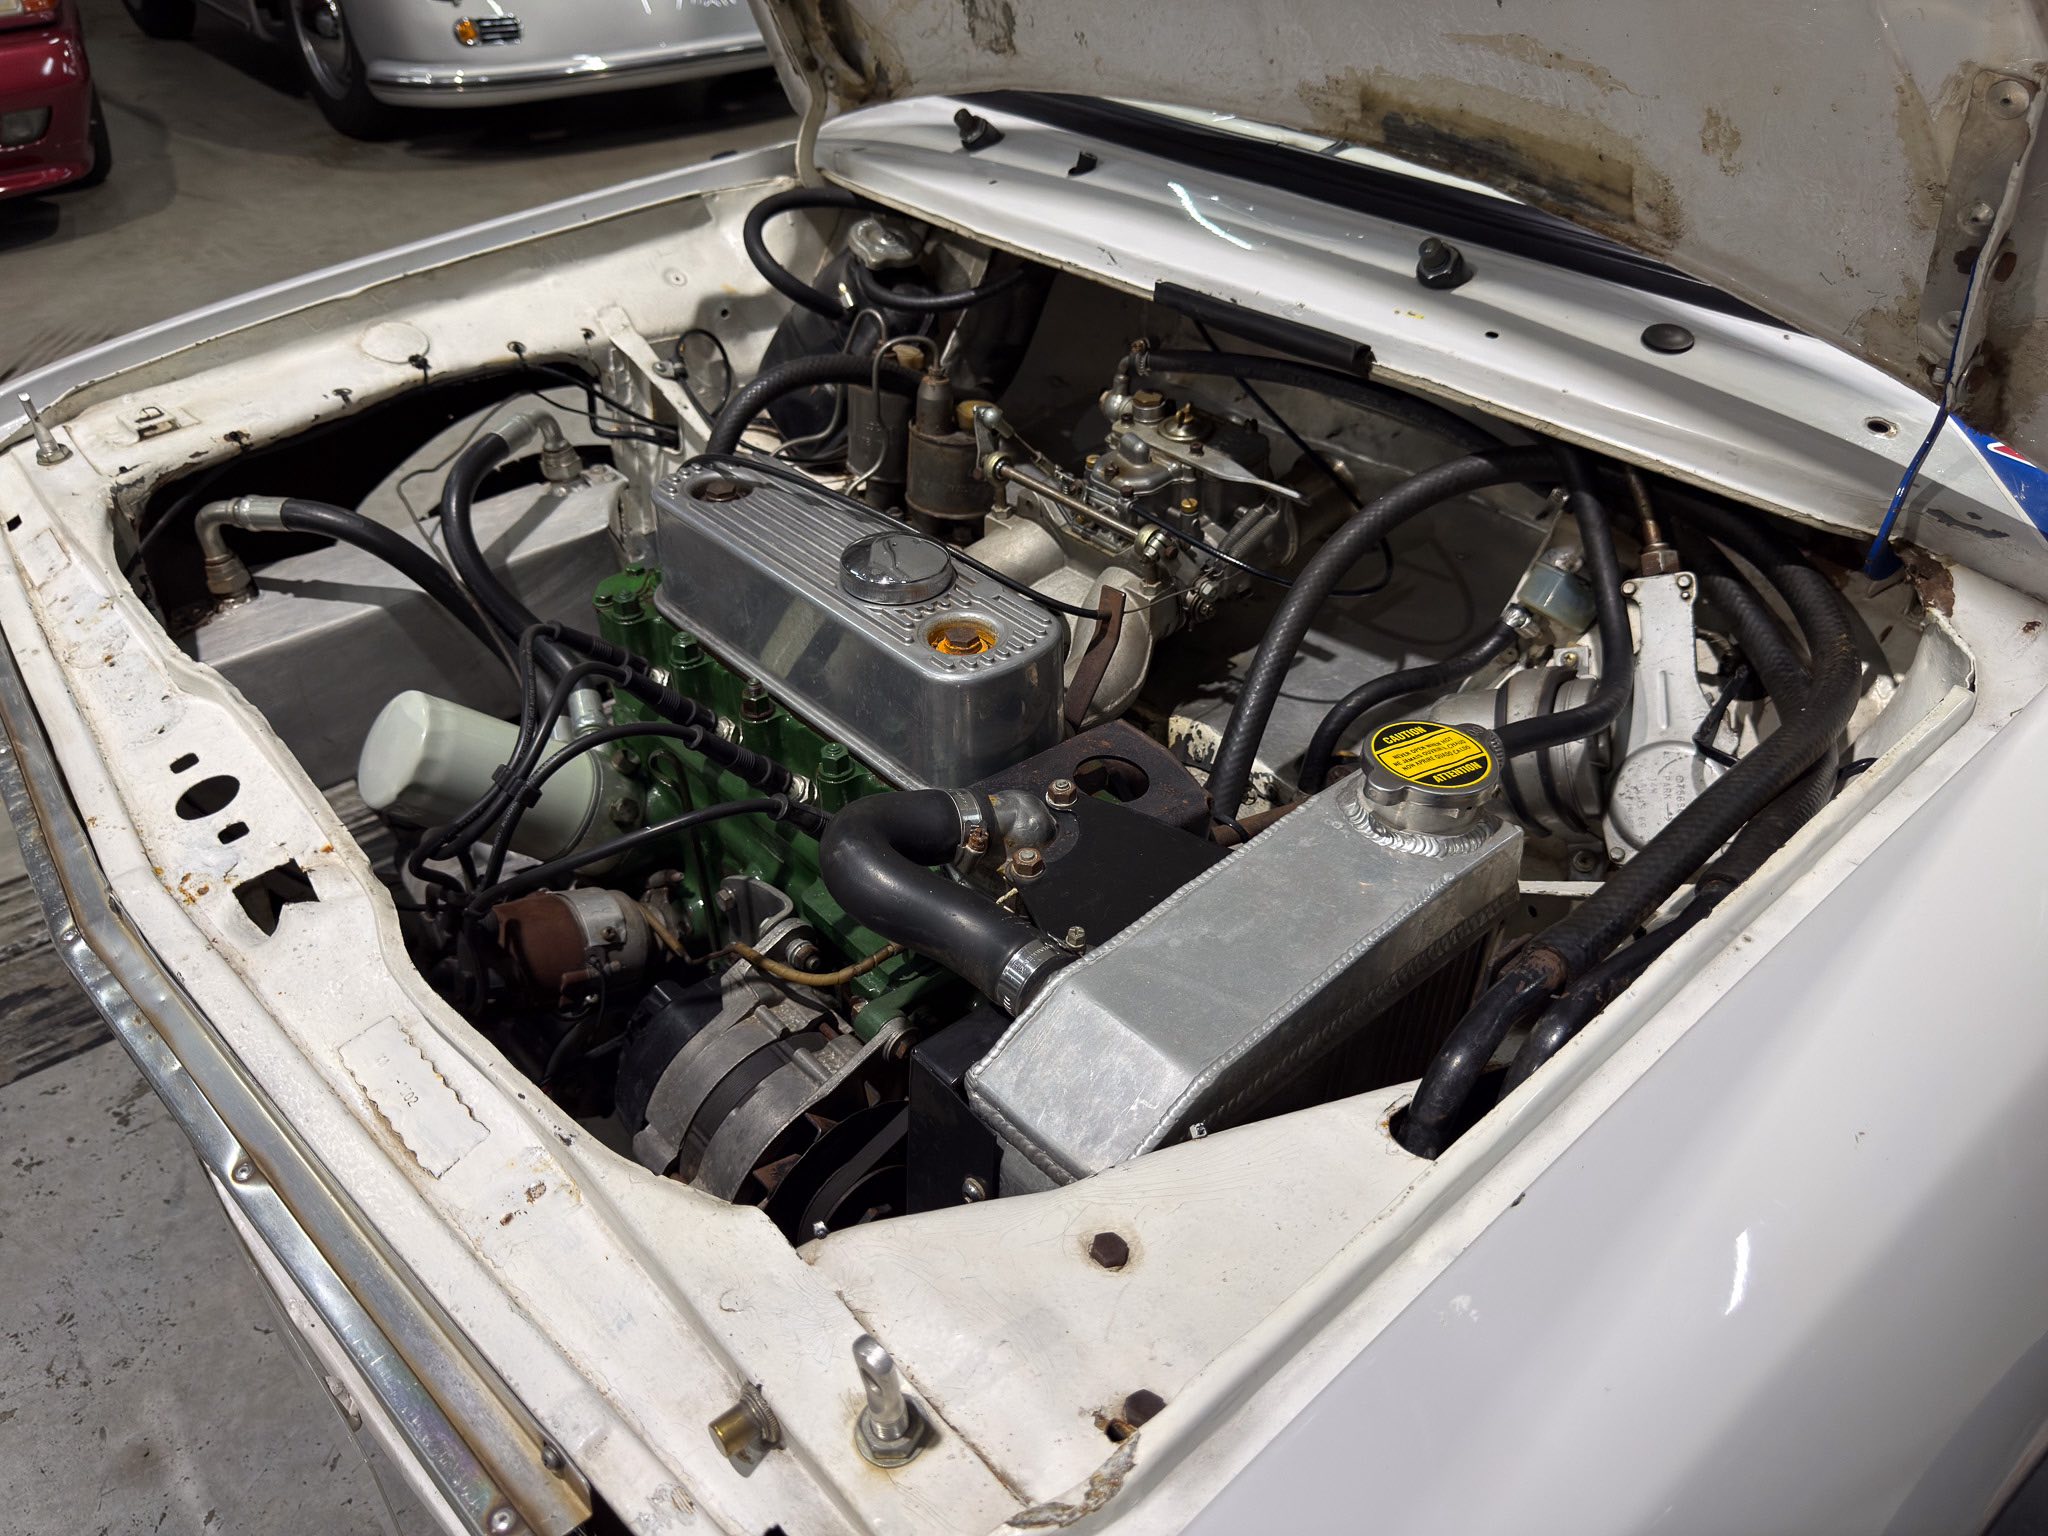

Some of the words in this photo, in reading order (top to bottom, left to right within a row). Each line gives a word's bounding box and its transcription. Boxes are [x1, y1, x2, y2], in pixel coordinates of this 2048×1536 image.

[1382, 726, 1427, 744] CAUTION
[1392, 751, 1411, 759] NEVER
[1410, 746, 1427, 754] OPEN
[1440, 736, 1453, 745] HOT
[1402, 754, 1423, 763] JAMAIS
[1446, 739, 1467, 749] CHAUD
[1402, 763, 1416, 771] NON
[1432, 761, 1483, 783] ATTENTION
[1663, 775, 1673, 799] PARK
